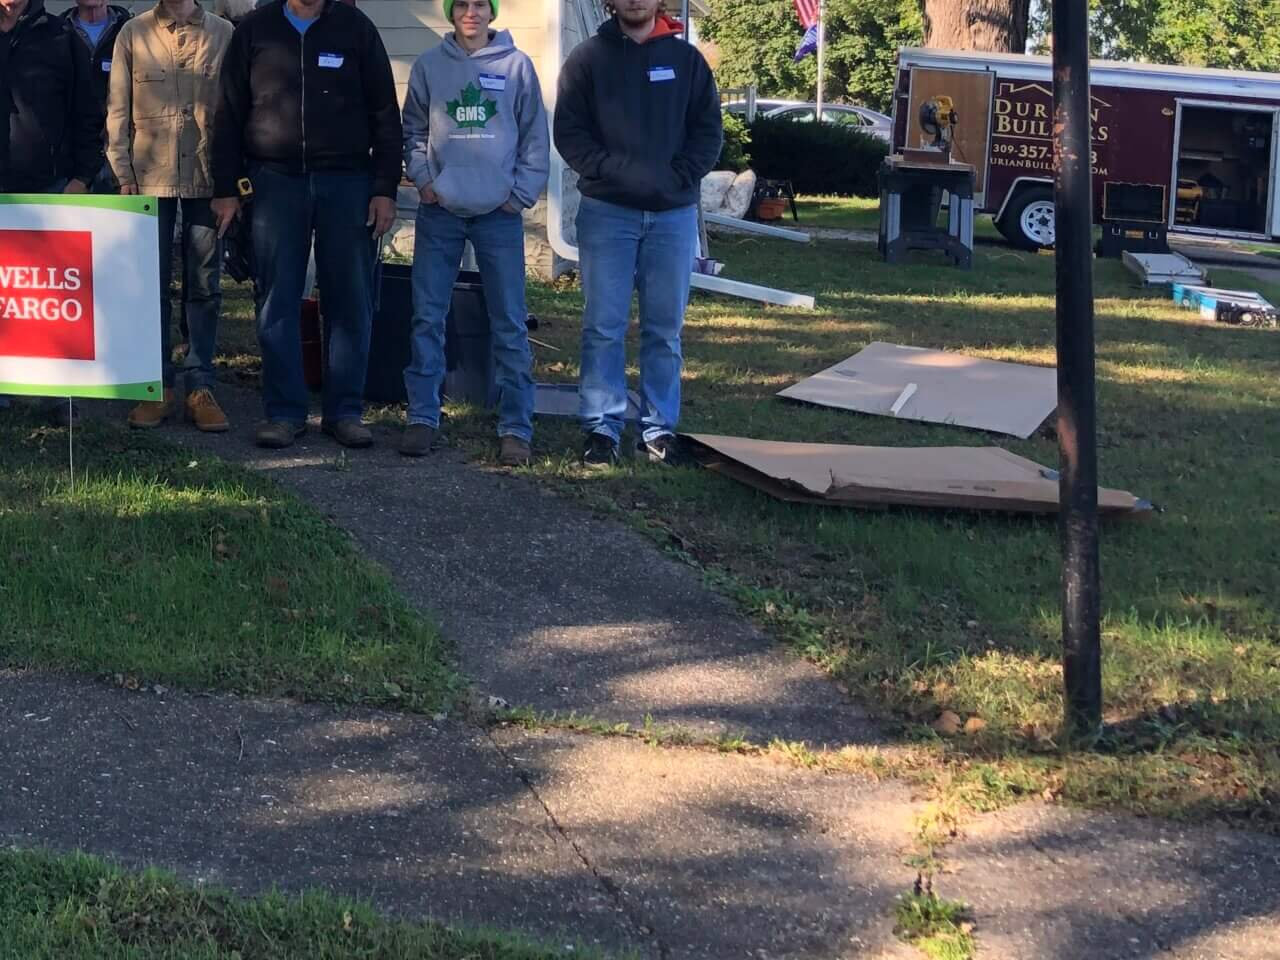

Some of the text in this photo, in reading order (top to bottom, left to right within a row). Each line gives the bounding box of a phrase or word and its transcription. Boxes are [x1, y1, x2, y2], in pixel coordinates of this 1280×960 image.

[455, 105, 487, 122] GMS
[994, 98, 1099, 122] DURN
[996, 114, 1109, 141] BUILS
